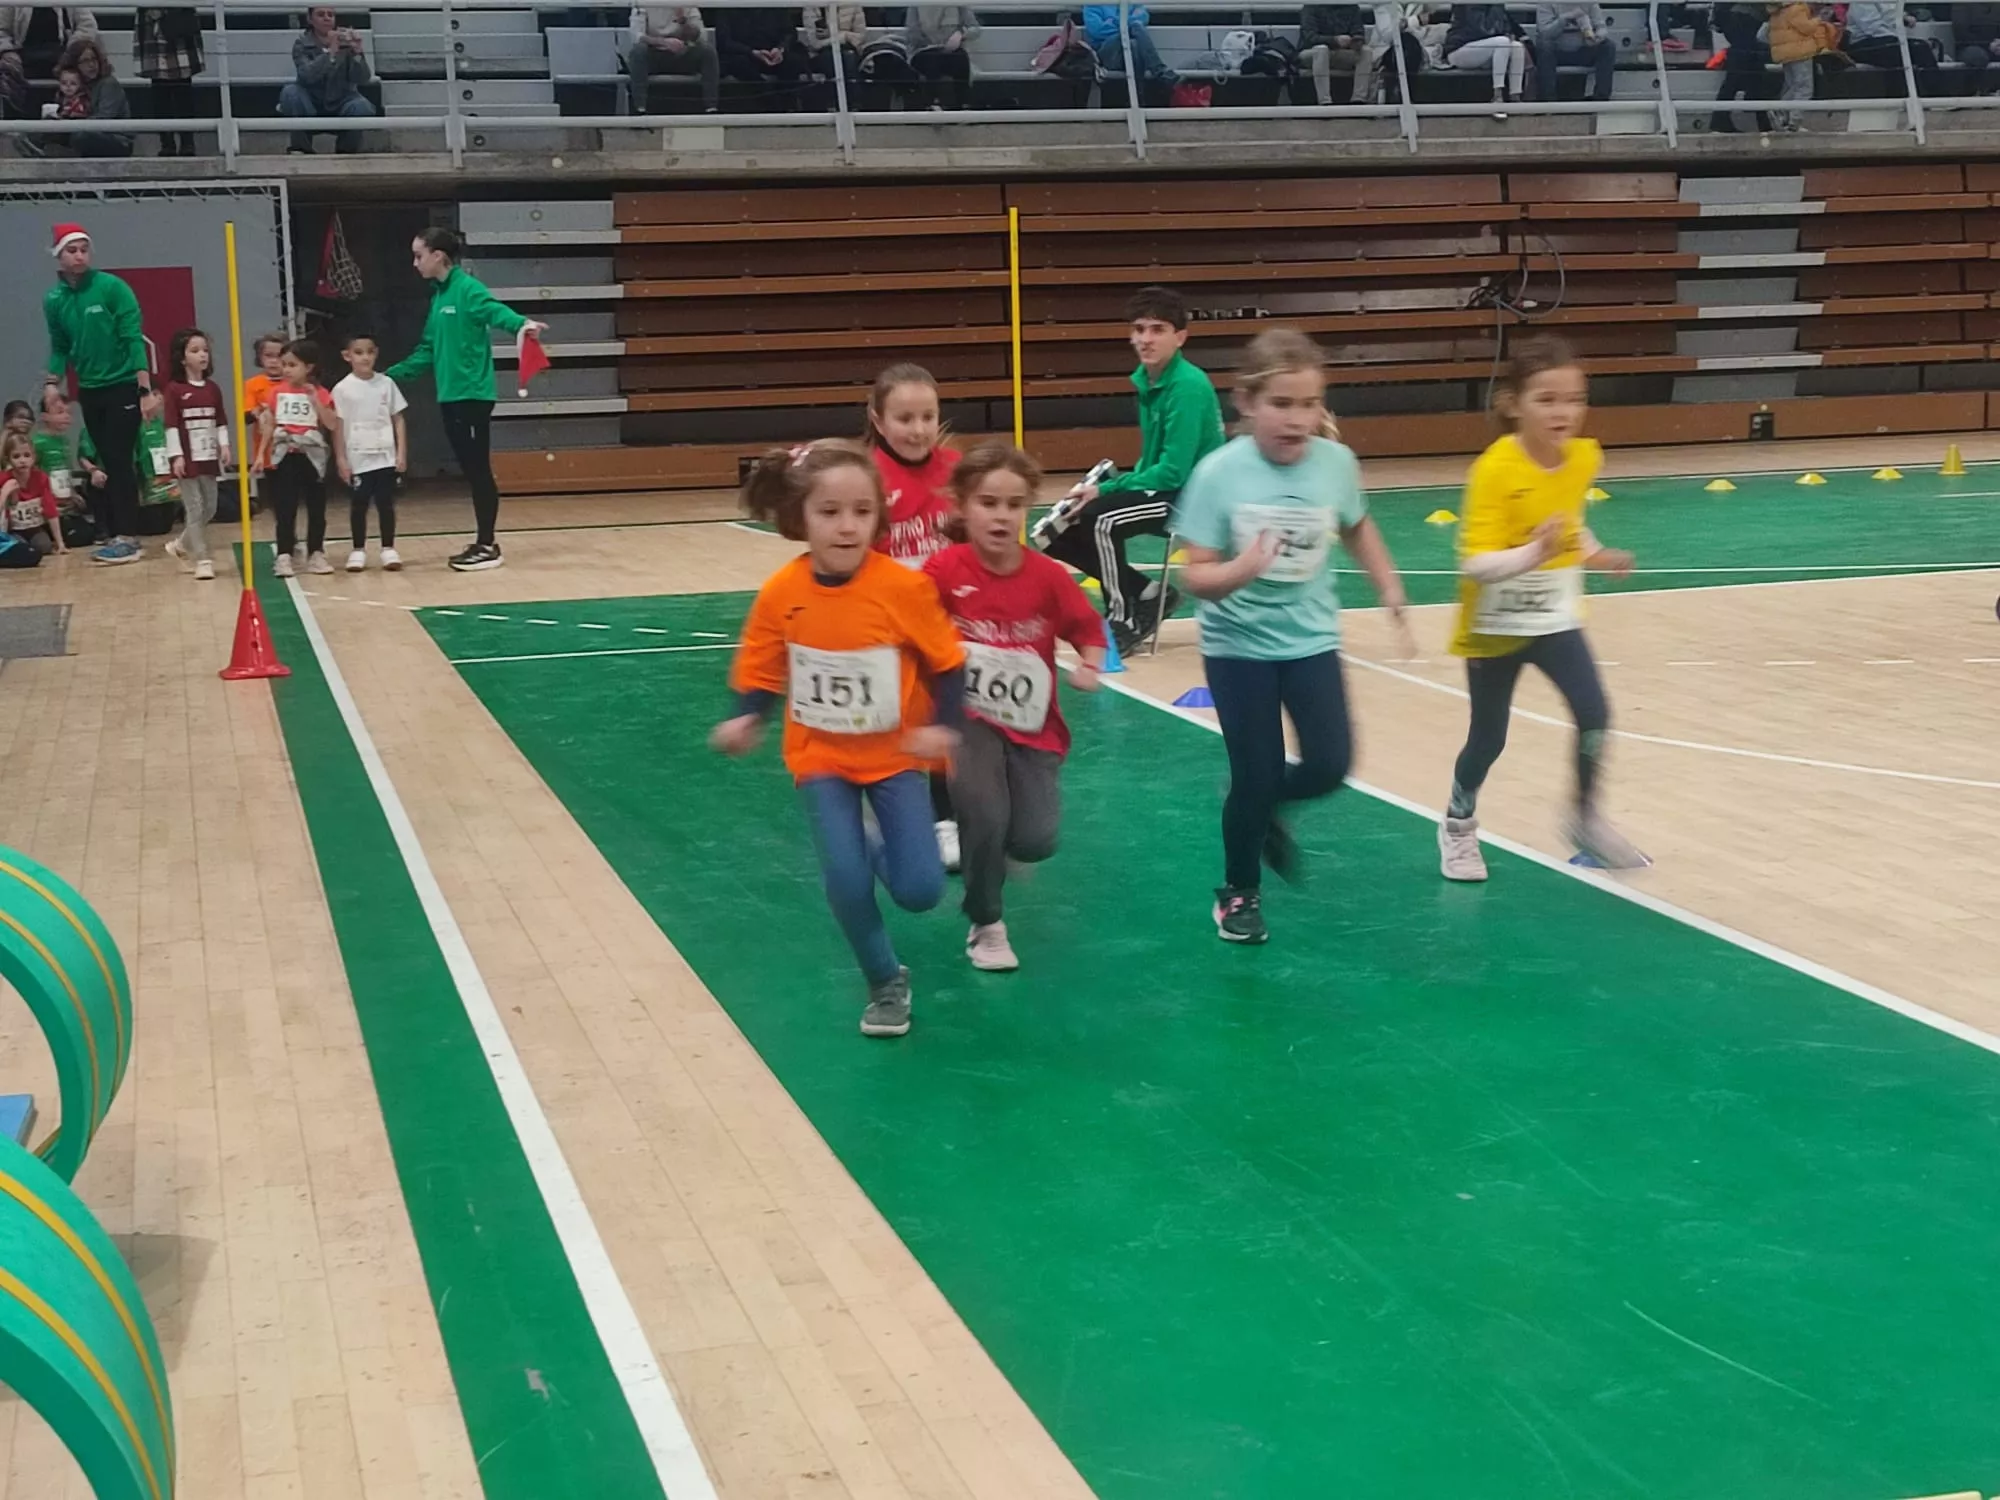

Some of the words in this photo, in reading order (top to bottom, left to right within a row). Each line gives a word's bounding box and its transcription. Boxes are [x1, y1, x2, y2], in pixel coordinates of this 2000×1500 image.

[283, 401, 310, 416] 153
[810, 673, 875, 708] 151
[965, 666, 1033, 708] 160
